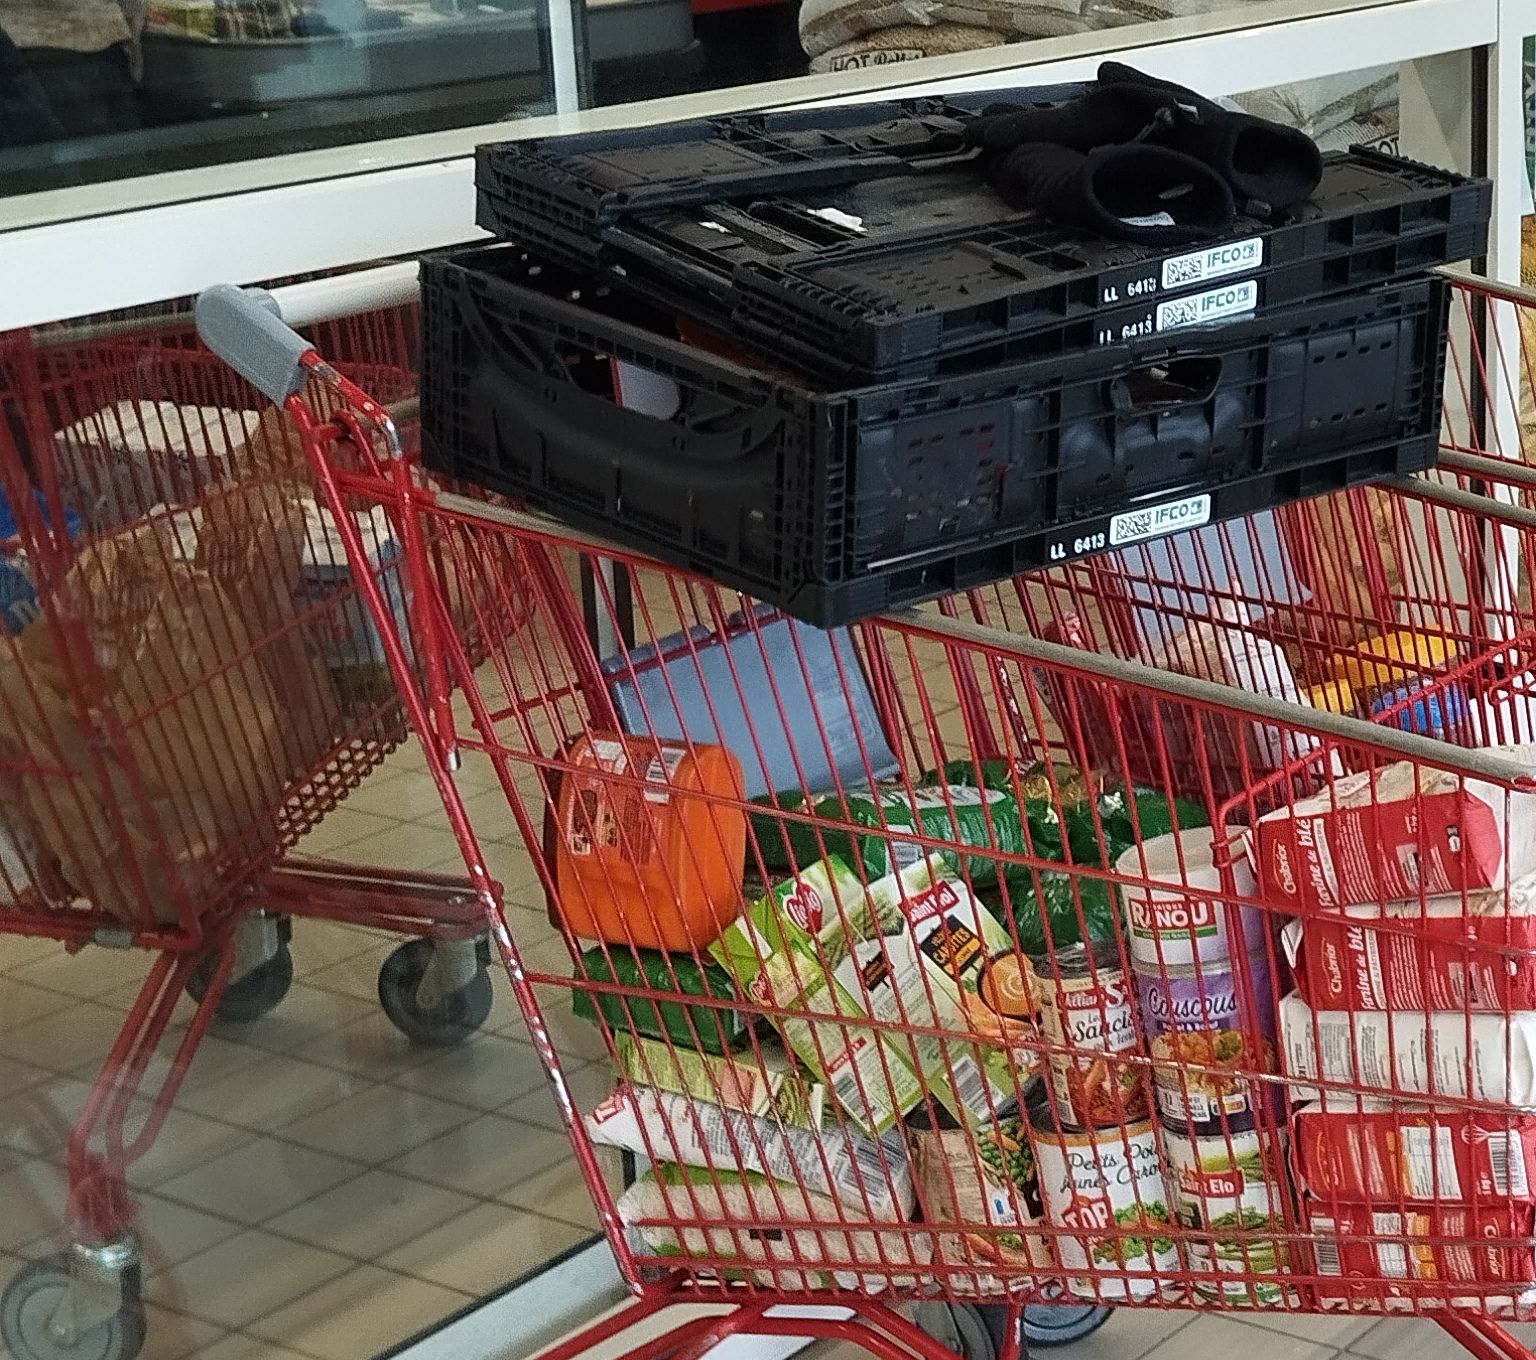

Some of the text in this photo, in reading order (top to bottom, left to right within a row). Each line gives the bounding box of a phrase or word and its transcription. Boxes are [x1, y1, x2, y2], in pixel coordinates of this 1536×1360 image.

[1207, 247, 1241, 268] IFCO
[1104, 286, 1119, 303] LL
[1201, 290, 1236, 313] IFCO
[1154, 503, 1189, 525] IFCO
[1050, 532, 1106, 560] LL 6413
[1296, 818, 1314, 848] blé
